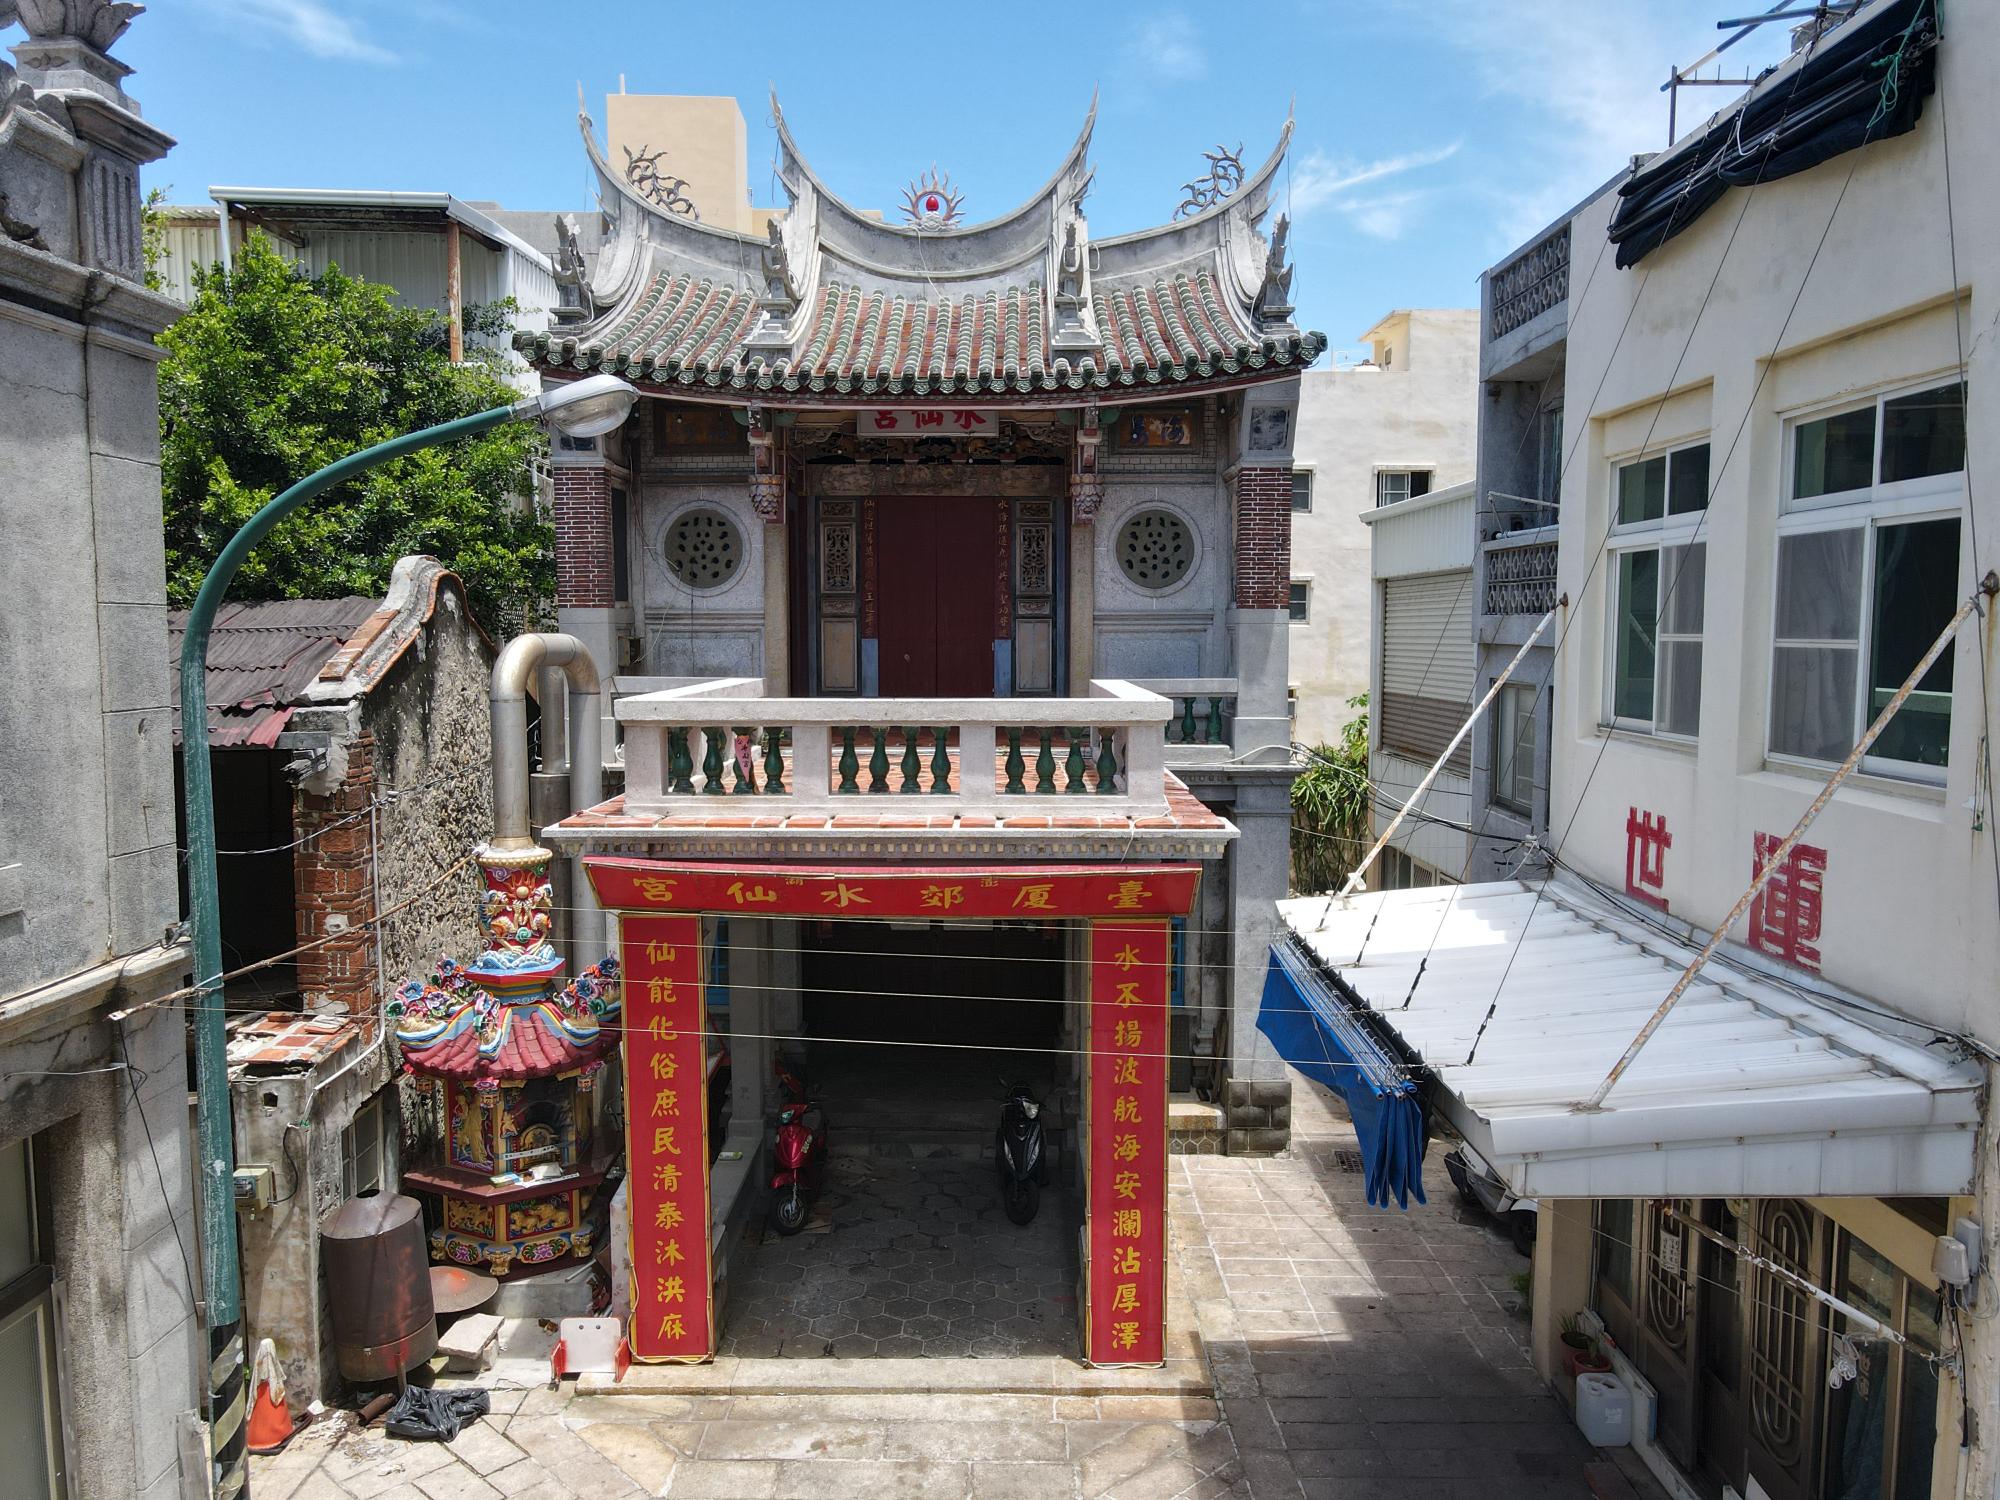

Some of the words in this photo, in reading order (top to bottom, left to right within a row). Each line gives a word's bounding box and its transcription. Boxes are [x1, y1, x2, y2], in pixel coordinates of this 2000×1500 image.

[1112, 943, 1144, 1351] 水不揚波航海安瀾沾厚澤
